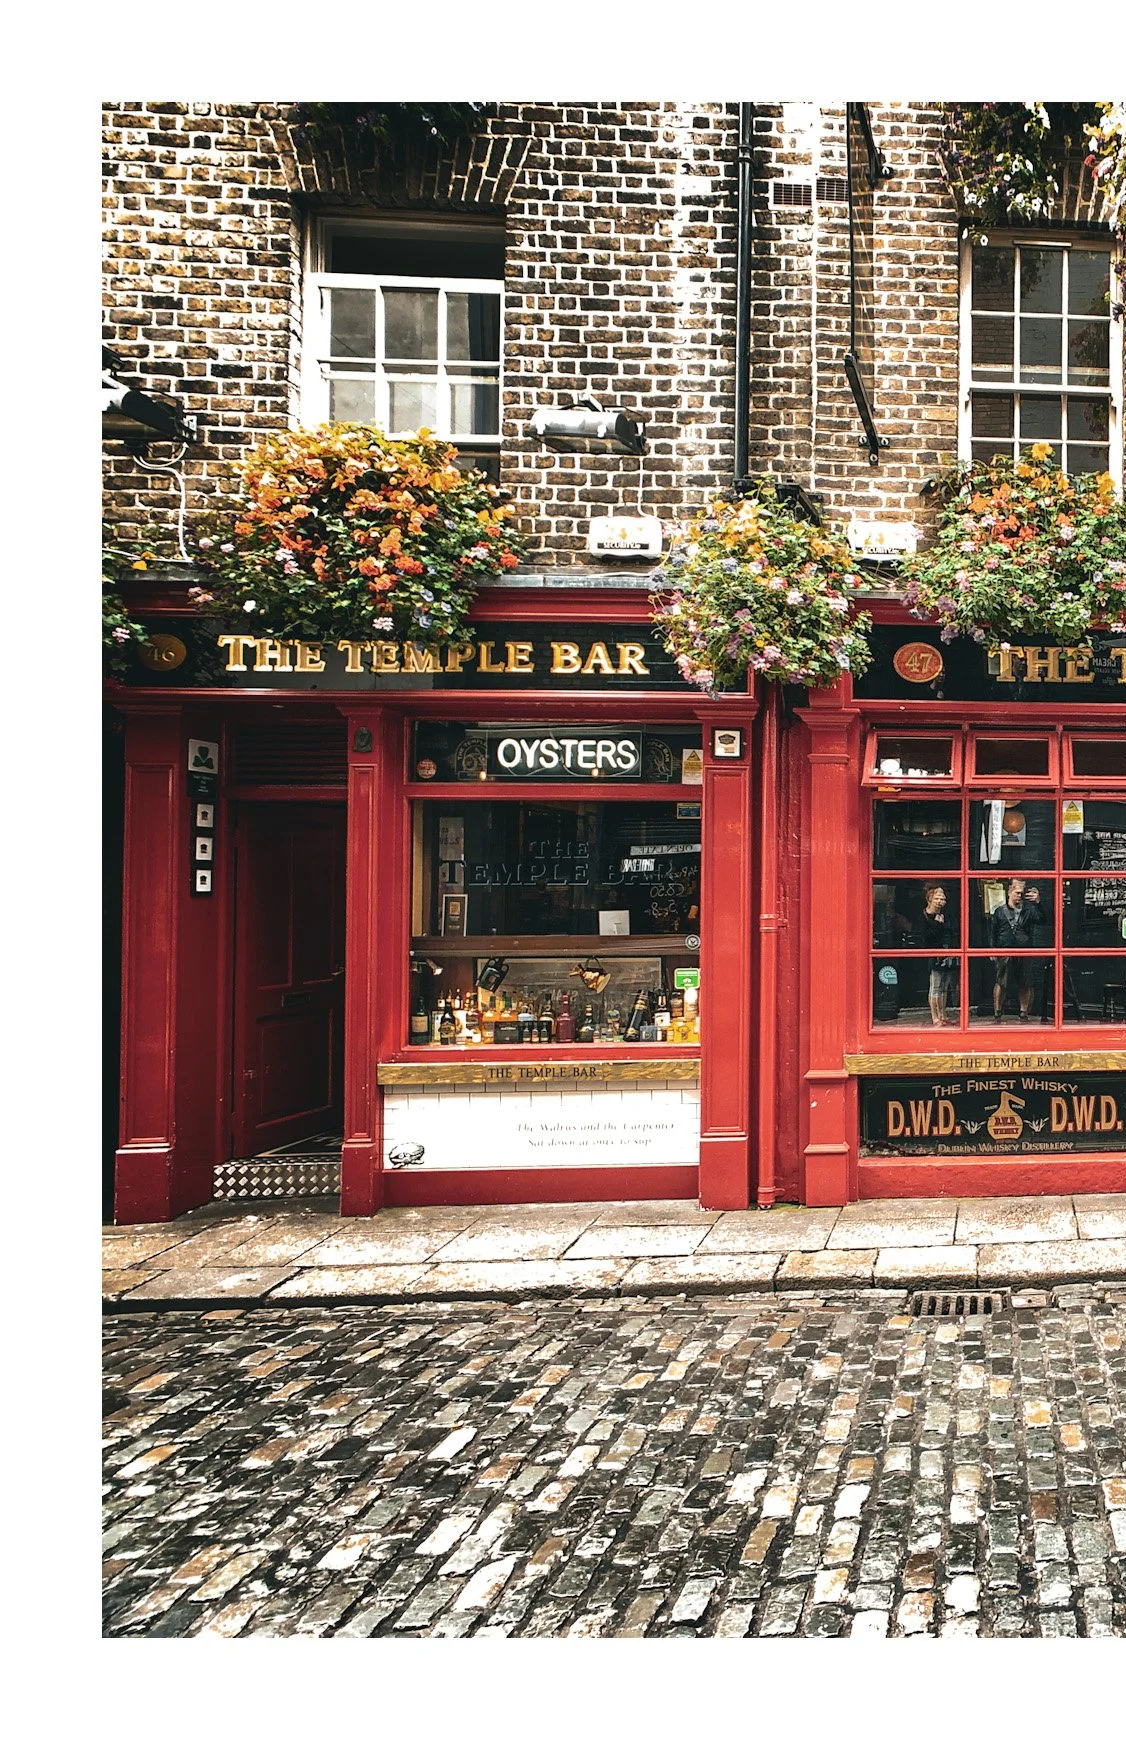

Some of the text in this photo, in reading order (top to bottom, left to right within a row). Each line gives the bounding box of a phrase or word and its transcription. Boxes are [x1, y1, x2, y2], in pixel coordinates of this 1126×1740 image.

[217, 634, 650, 675] THE TEMPLE BAR
[905, 654, 933, 674] 47
[988, 646, 1096, 683] THE
[497, 738, 635, 769] OYSTERS
[530, 840, 589, 858] THE
[440, 861, 589, 885] TEMPLE
[488, 1066, 597, 1078] THE TEMPLE BAR
[958, 1056, 1059, 1068] THE TEMPLE BAR
[932, 1077, 1079, 1098] THE FINEST WHISKY
[887, 1099, 961, 1138] D.W.D.
[1051, 1095, 1123, 1132] D.W.D.
[540, 1122, 577, 1131] Walrus
[938, 1141, 1074, 1153] DUBLIN WHISKY DISTILLERY
